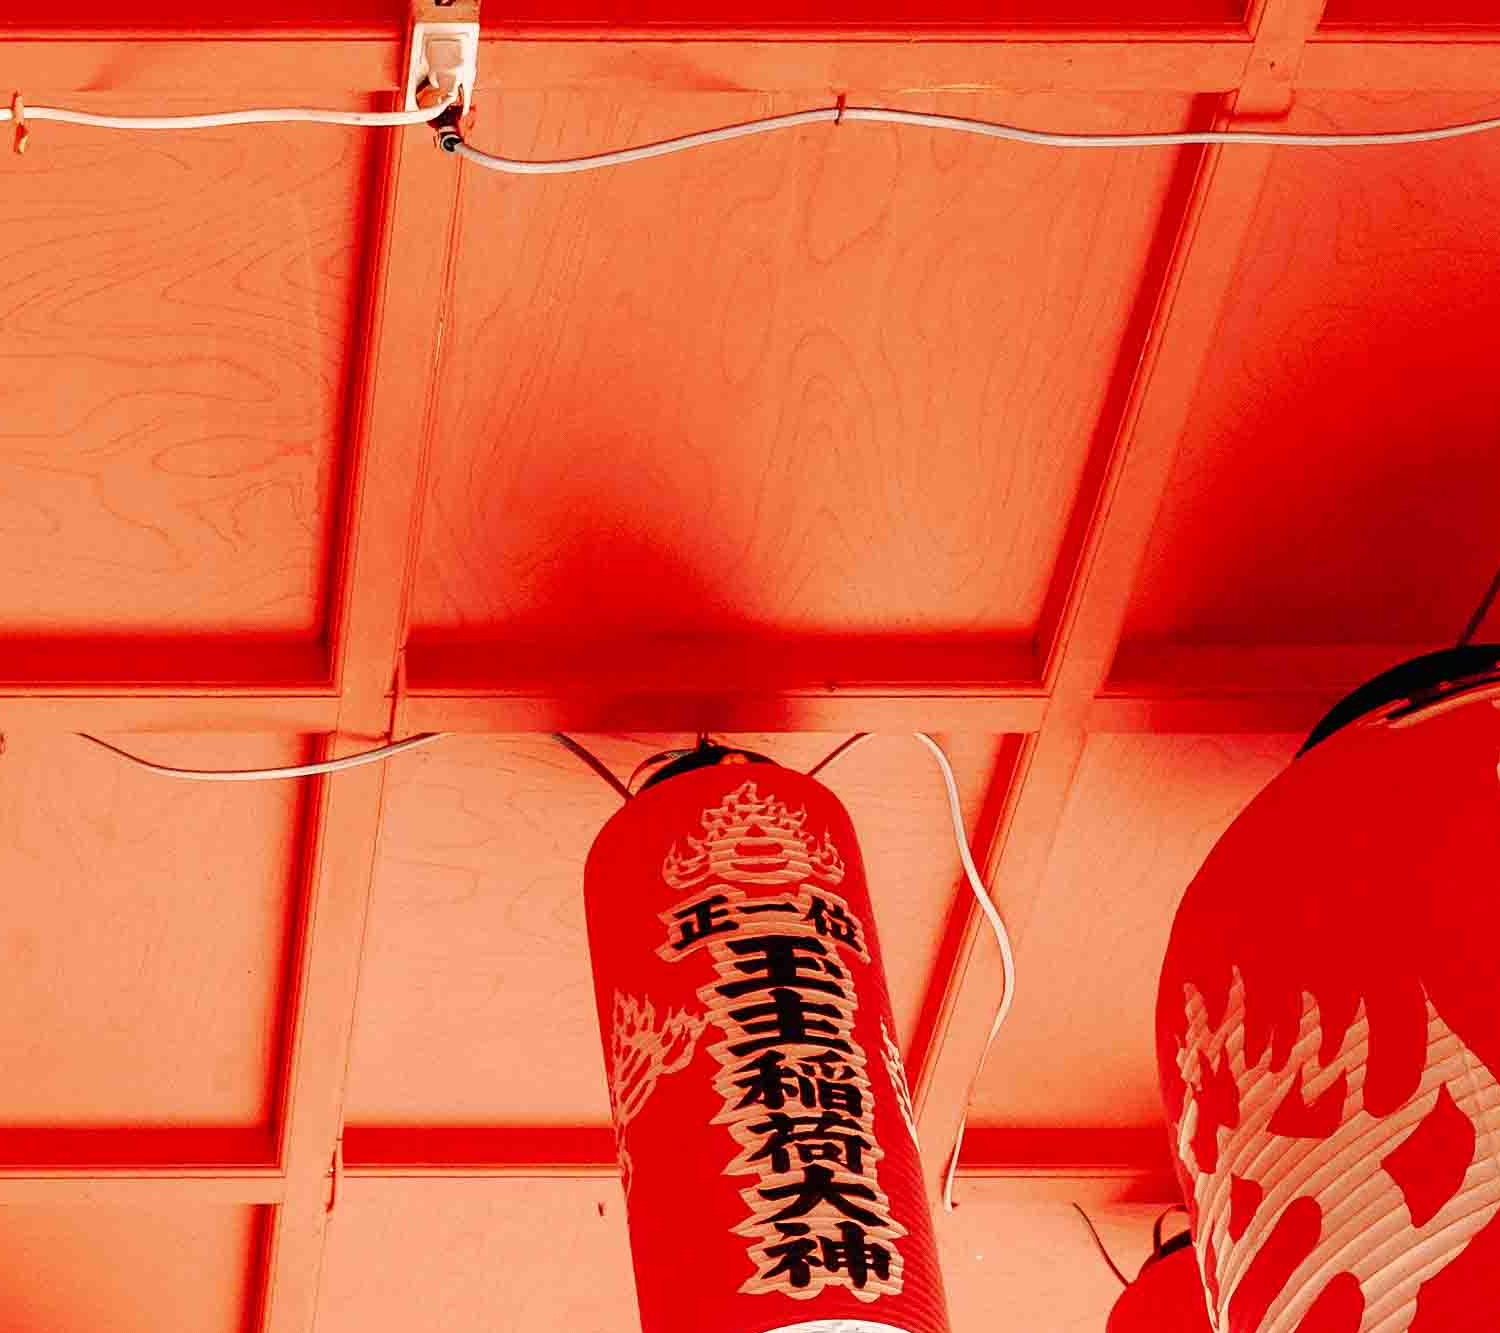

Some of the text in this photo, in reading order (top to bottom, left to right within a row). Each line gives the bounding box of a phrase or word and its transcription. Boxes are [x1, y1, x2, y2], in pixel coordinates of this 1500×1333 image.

[672, 892, 865, 950] 正一位
[714, 934, 893, 1291] 玉主稲荷大神
